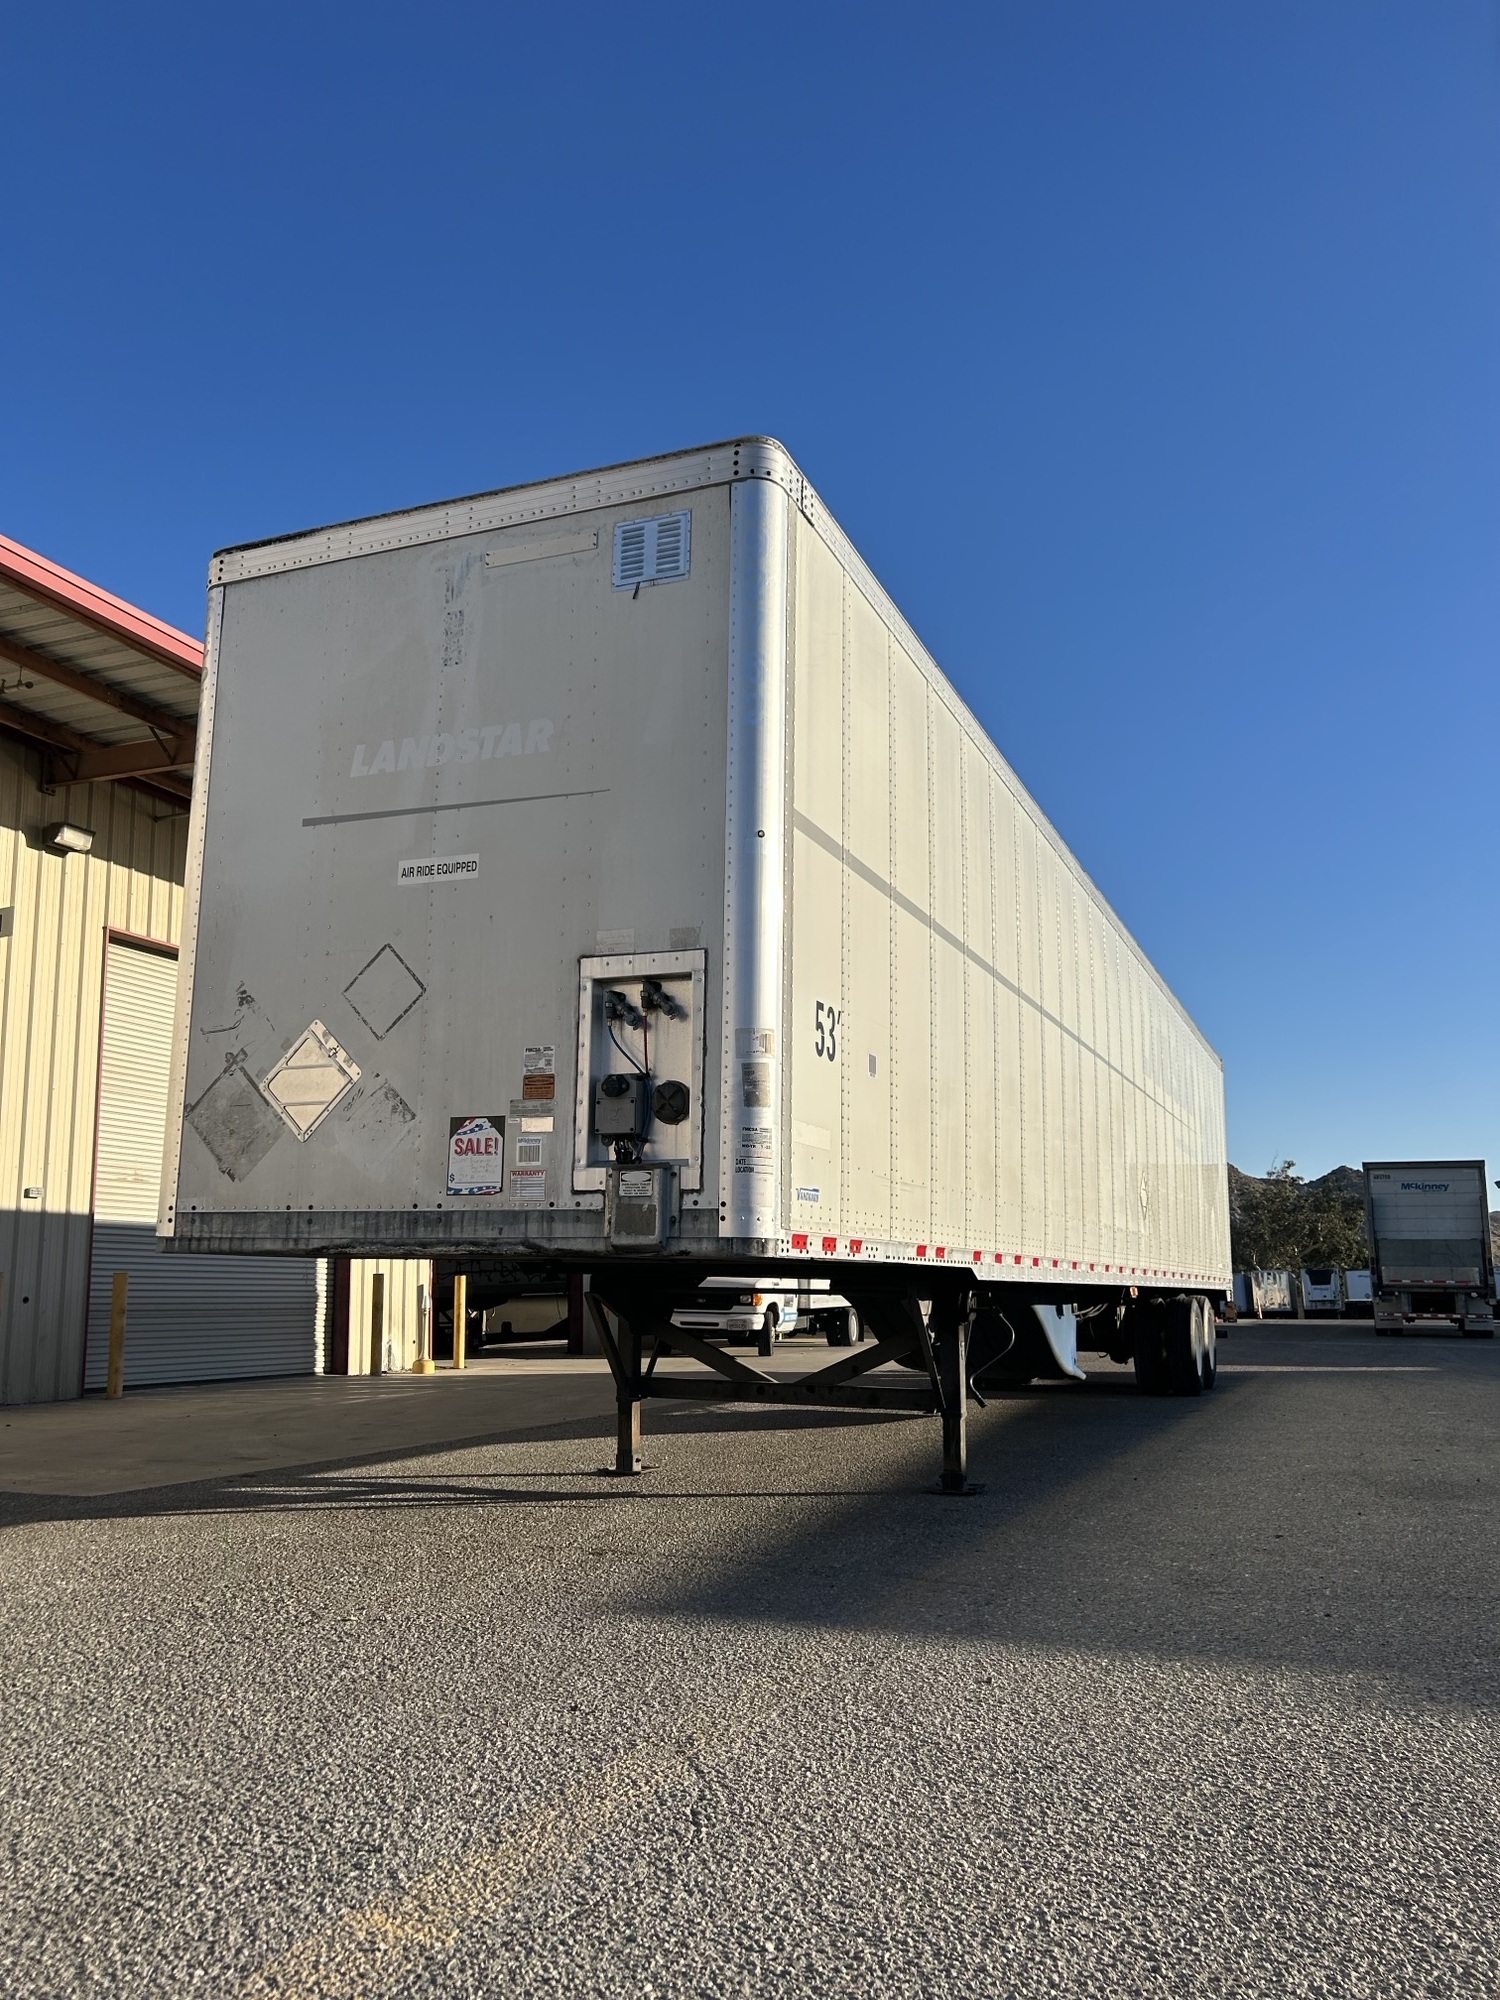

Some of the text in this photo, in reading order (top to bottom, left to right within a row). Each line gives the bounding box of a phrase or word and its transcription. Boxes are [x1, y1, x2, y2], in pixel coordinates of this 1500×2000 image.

[350, 718, 555, 777] LANDSTAR
[401, 860, 478, 878] AIR RIDE EQUIPPED
[454, 1136, 499, 1156] SALE!
